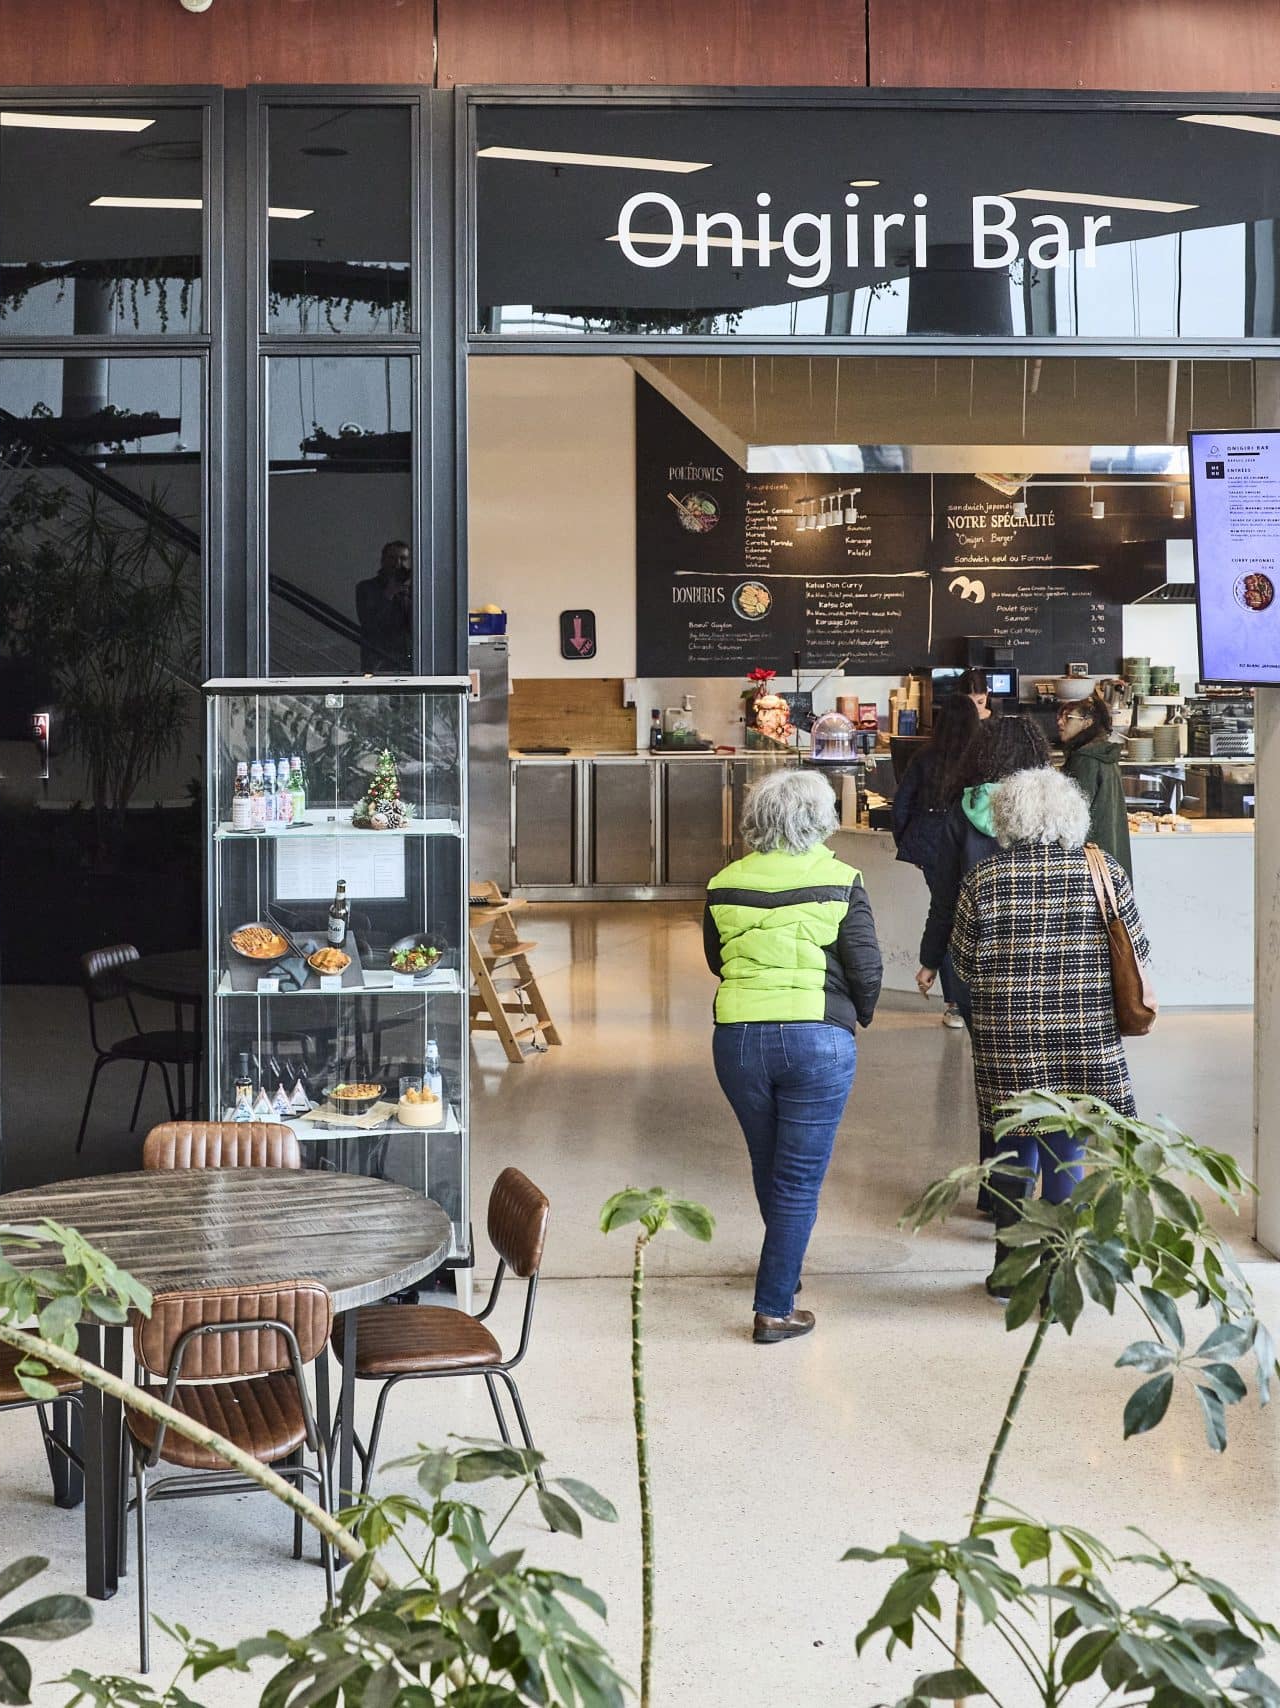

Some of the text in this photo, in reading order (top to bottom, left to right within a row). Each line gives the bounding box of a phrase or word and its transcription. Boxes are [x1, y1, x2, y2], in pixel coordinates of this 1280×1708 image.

[617, 191, 1112, 288] Onigiri Bar
[668, 461, 724, 482] POKÉBOWLS
[948, 502, 1014, 513] sandwich japonai
[947, 510, 1056, 529] NOTRE SPÉCIALITÉ
[847, 549, 872, 557] Falafel
[954, 555, 990, 564] Sandwich
[1009, 555, 1020, 563] ou
[1020, 554, 1053, 562] Formule
[826, 581, 840, 589] Don
[841, 581, 863, 591] Curry
[672, 586, 726, 604] DONBURIS
[1019, 604, 1039, 614] Spicy
[815, 619, 844, 628] Karaage
